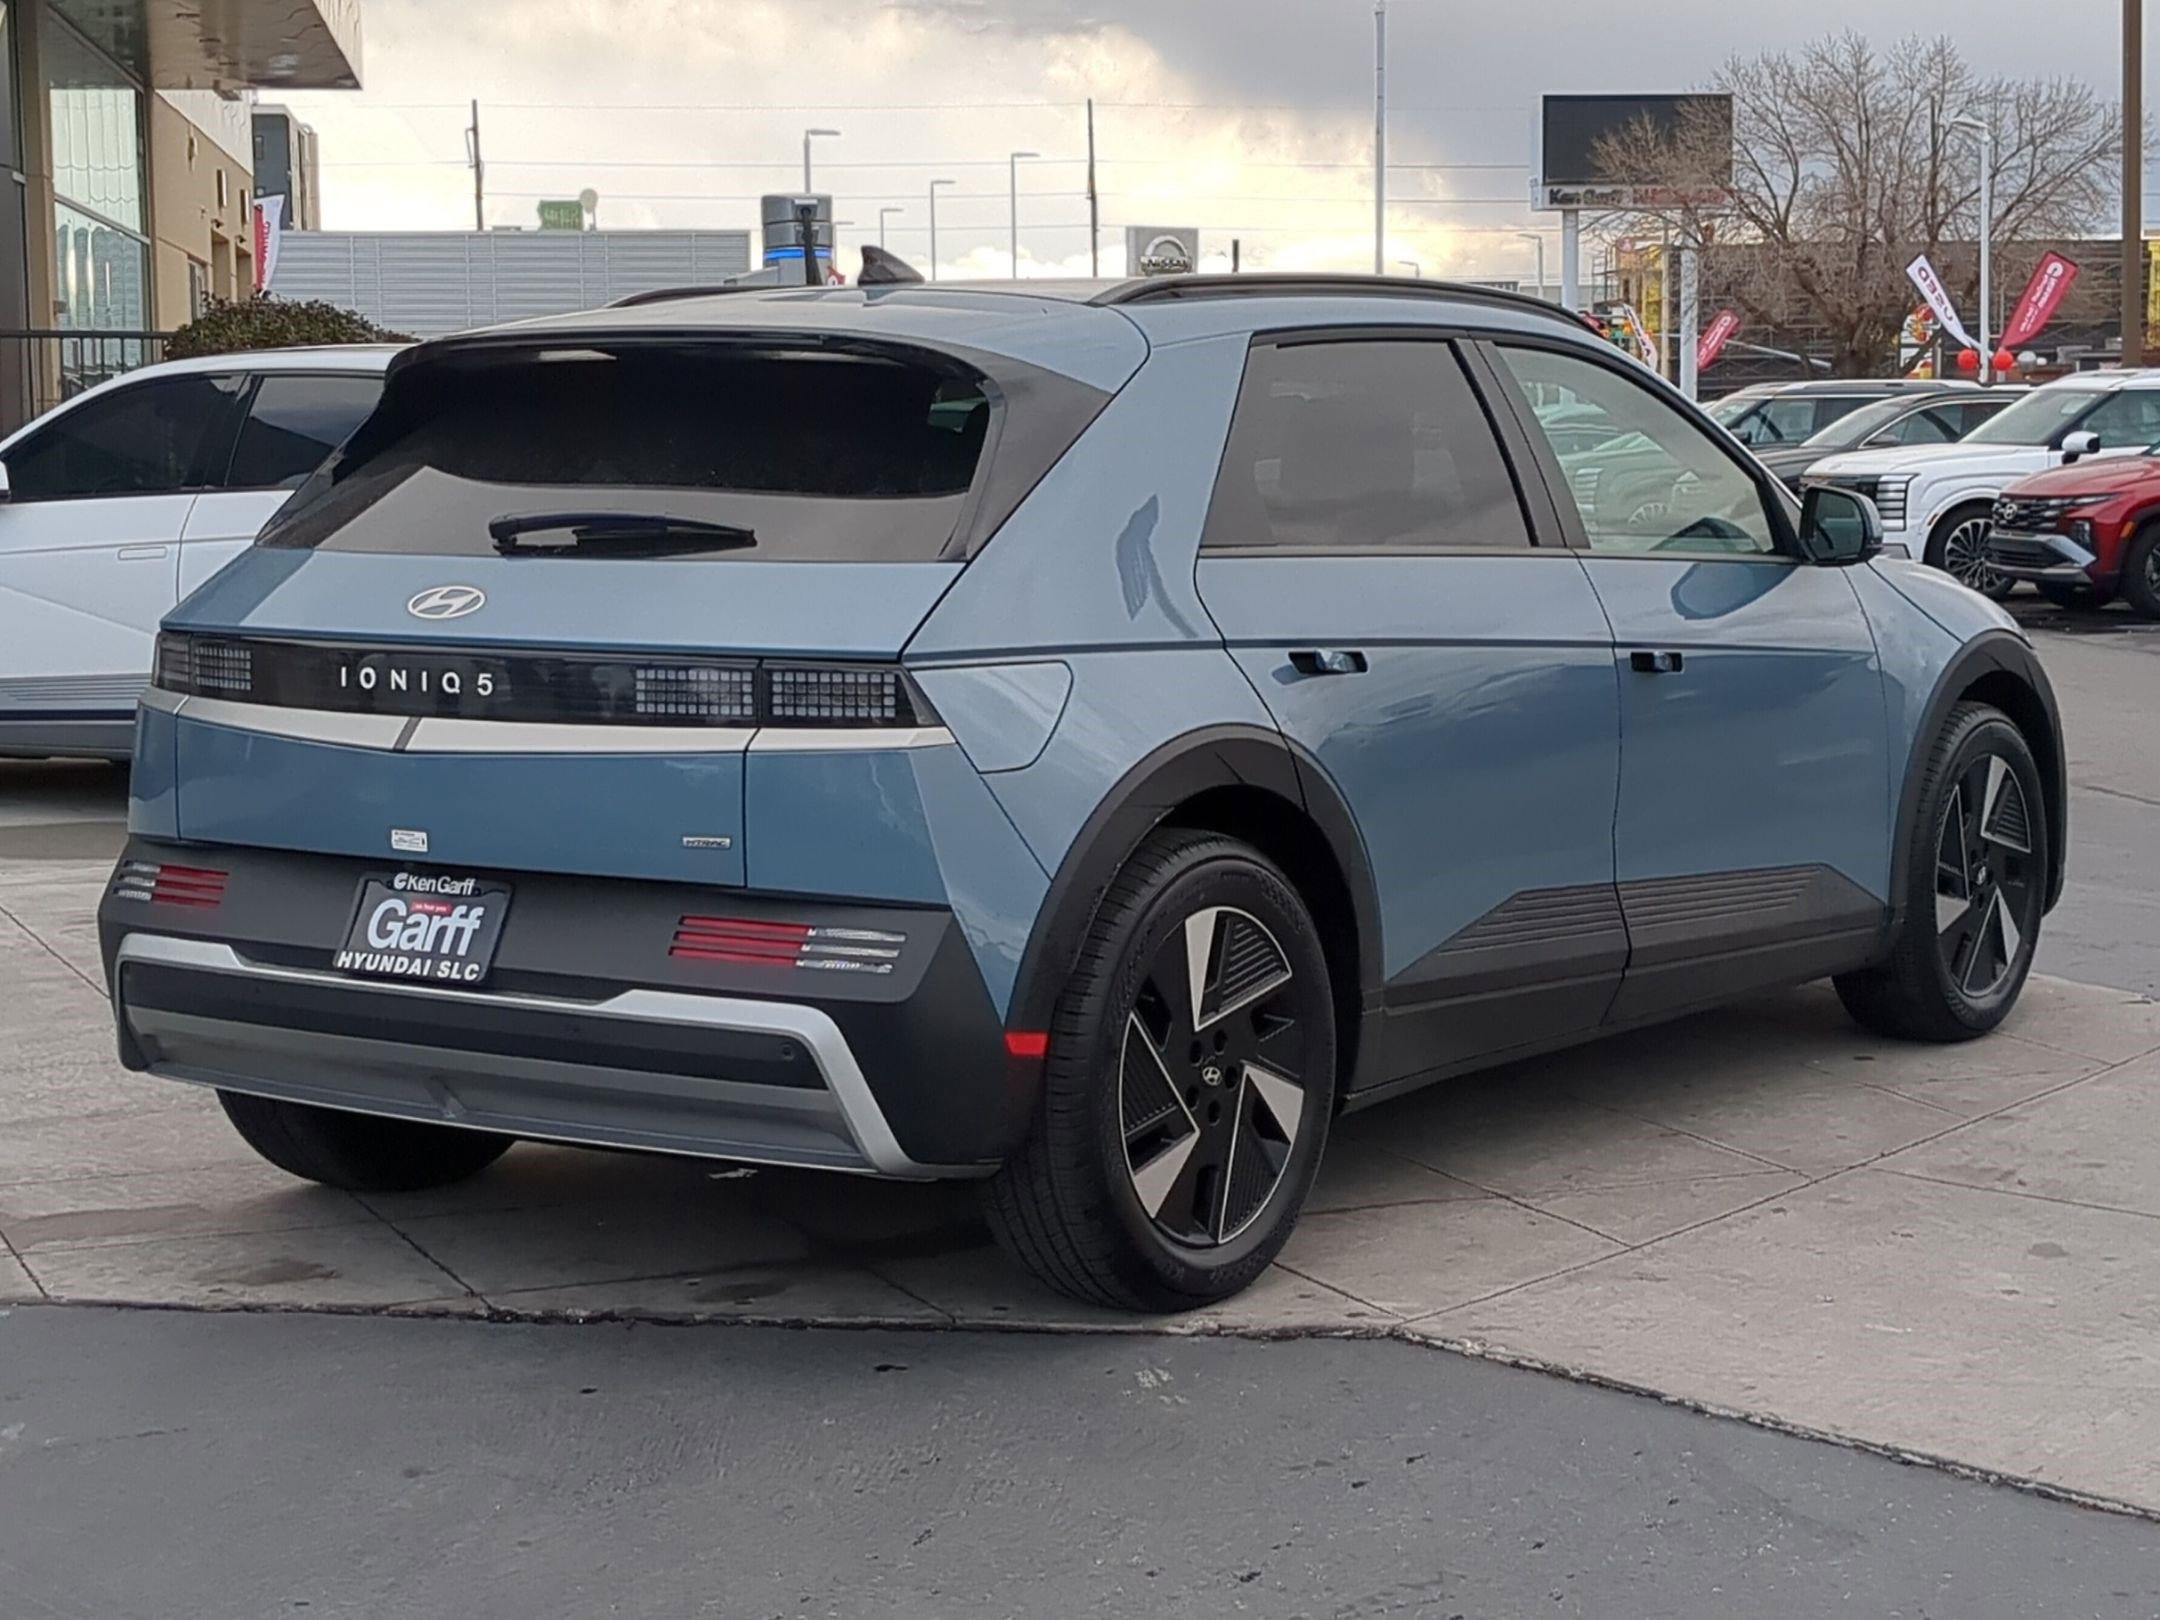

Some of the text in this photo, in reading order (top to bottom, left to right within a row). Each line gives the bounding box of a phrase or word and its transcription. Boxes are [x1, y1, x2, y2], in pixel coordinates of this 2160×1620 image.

[340, 666, 493, 696] IONIQ 5
[406, 874, 476, 896] Ken Garff
[367, 898, 485, 956] Garff
[337, 950, 480, 981] HYUNDAI SLC
